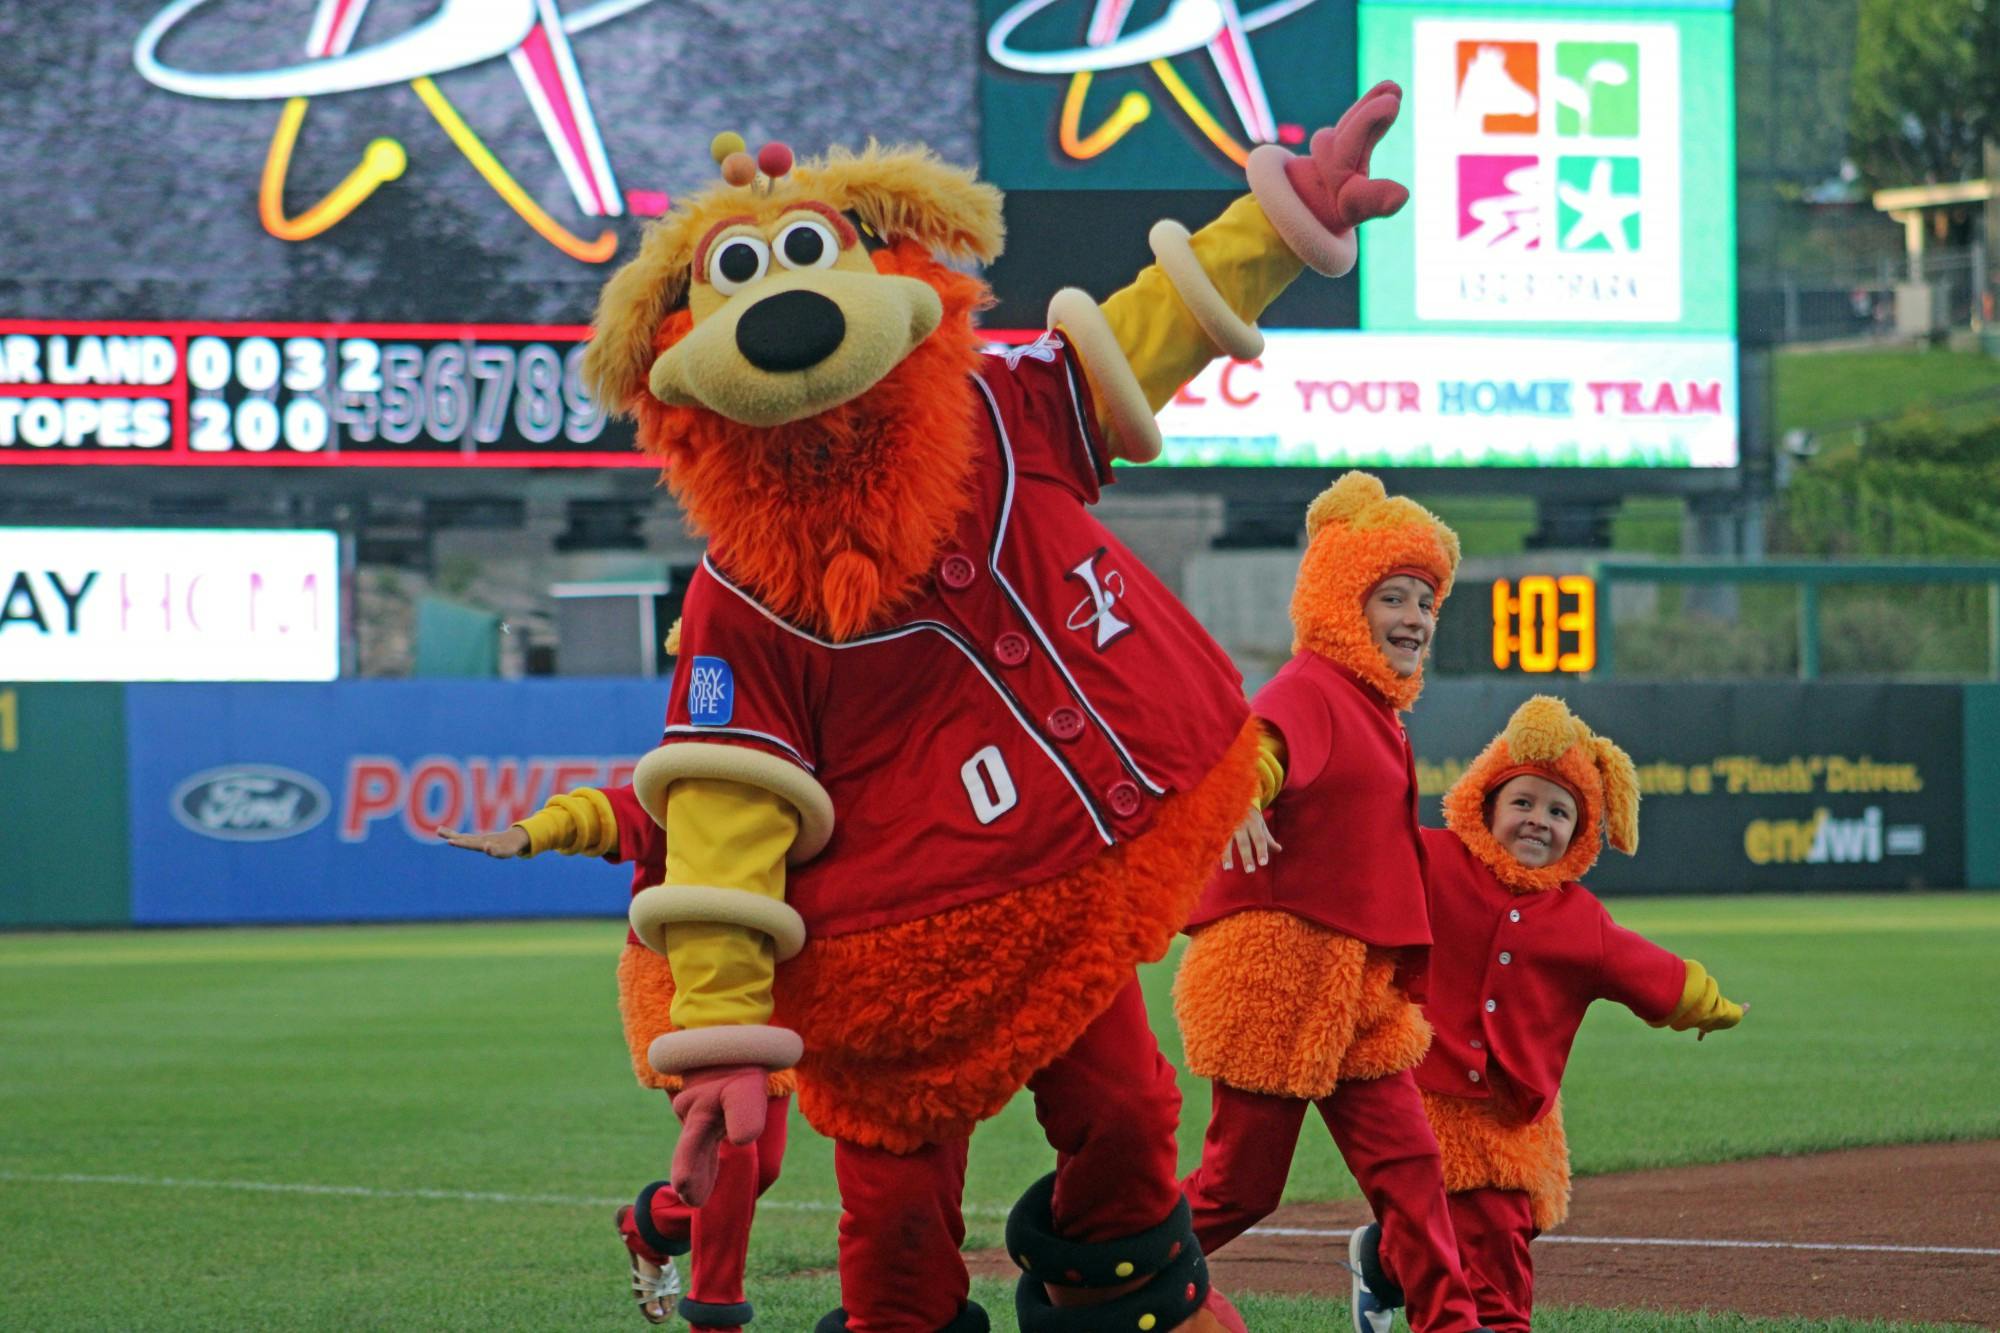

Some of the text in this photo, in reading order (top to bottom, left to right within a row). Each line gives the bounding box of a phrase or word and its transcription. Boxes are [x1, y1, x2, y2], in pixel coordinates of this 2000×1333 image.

[47, 335, 178, 386] LAND
[1294, 380, 1422, 413] YOUR
[1437, 379, 1572, 416] HOME
[1586, 380, 1721, 416] TEAM
[1492, 575, 1596, 673] 1:03
[201, 757, 638, 842] Ford POW
